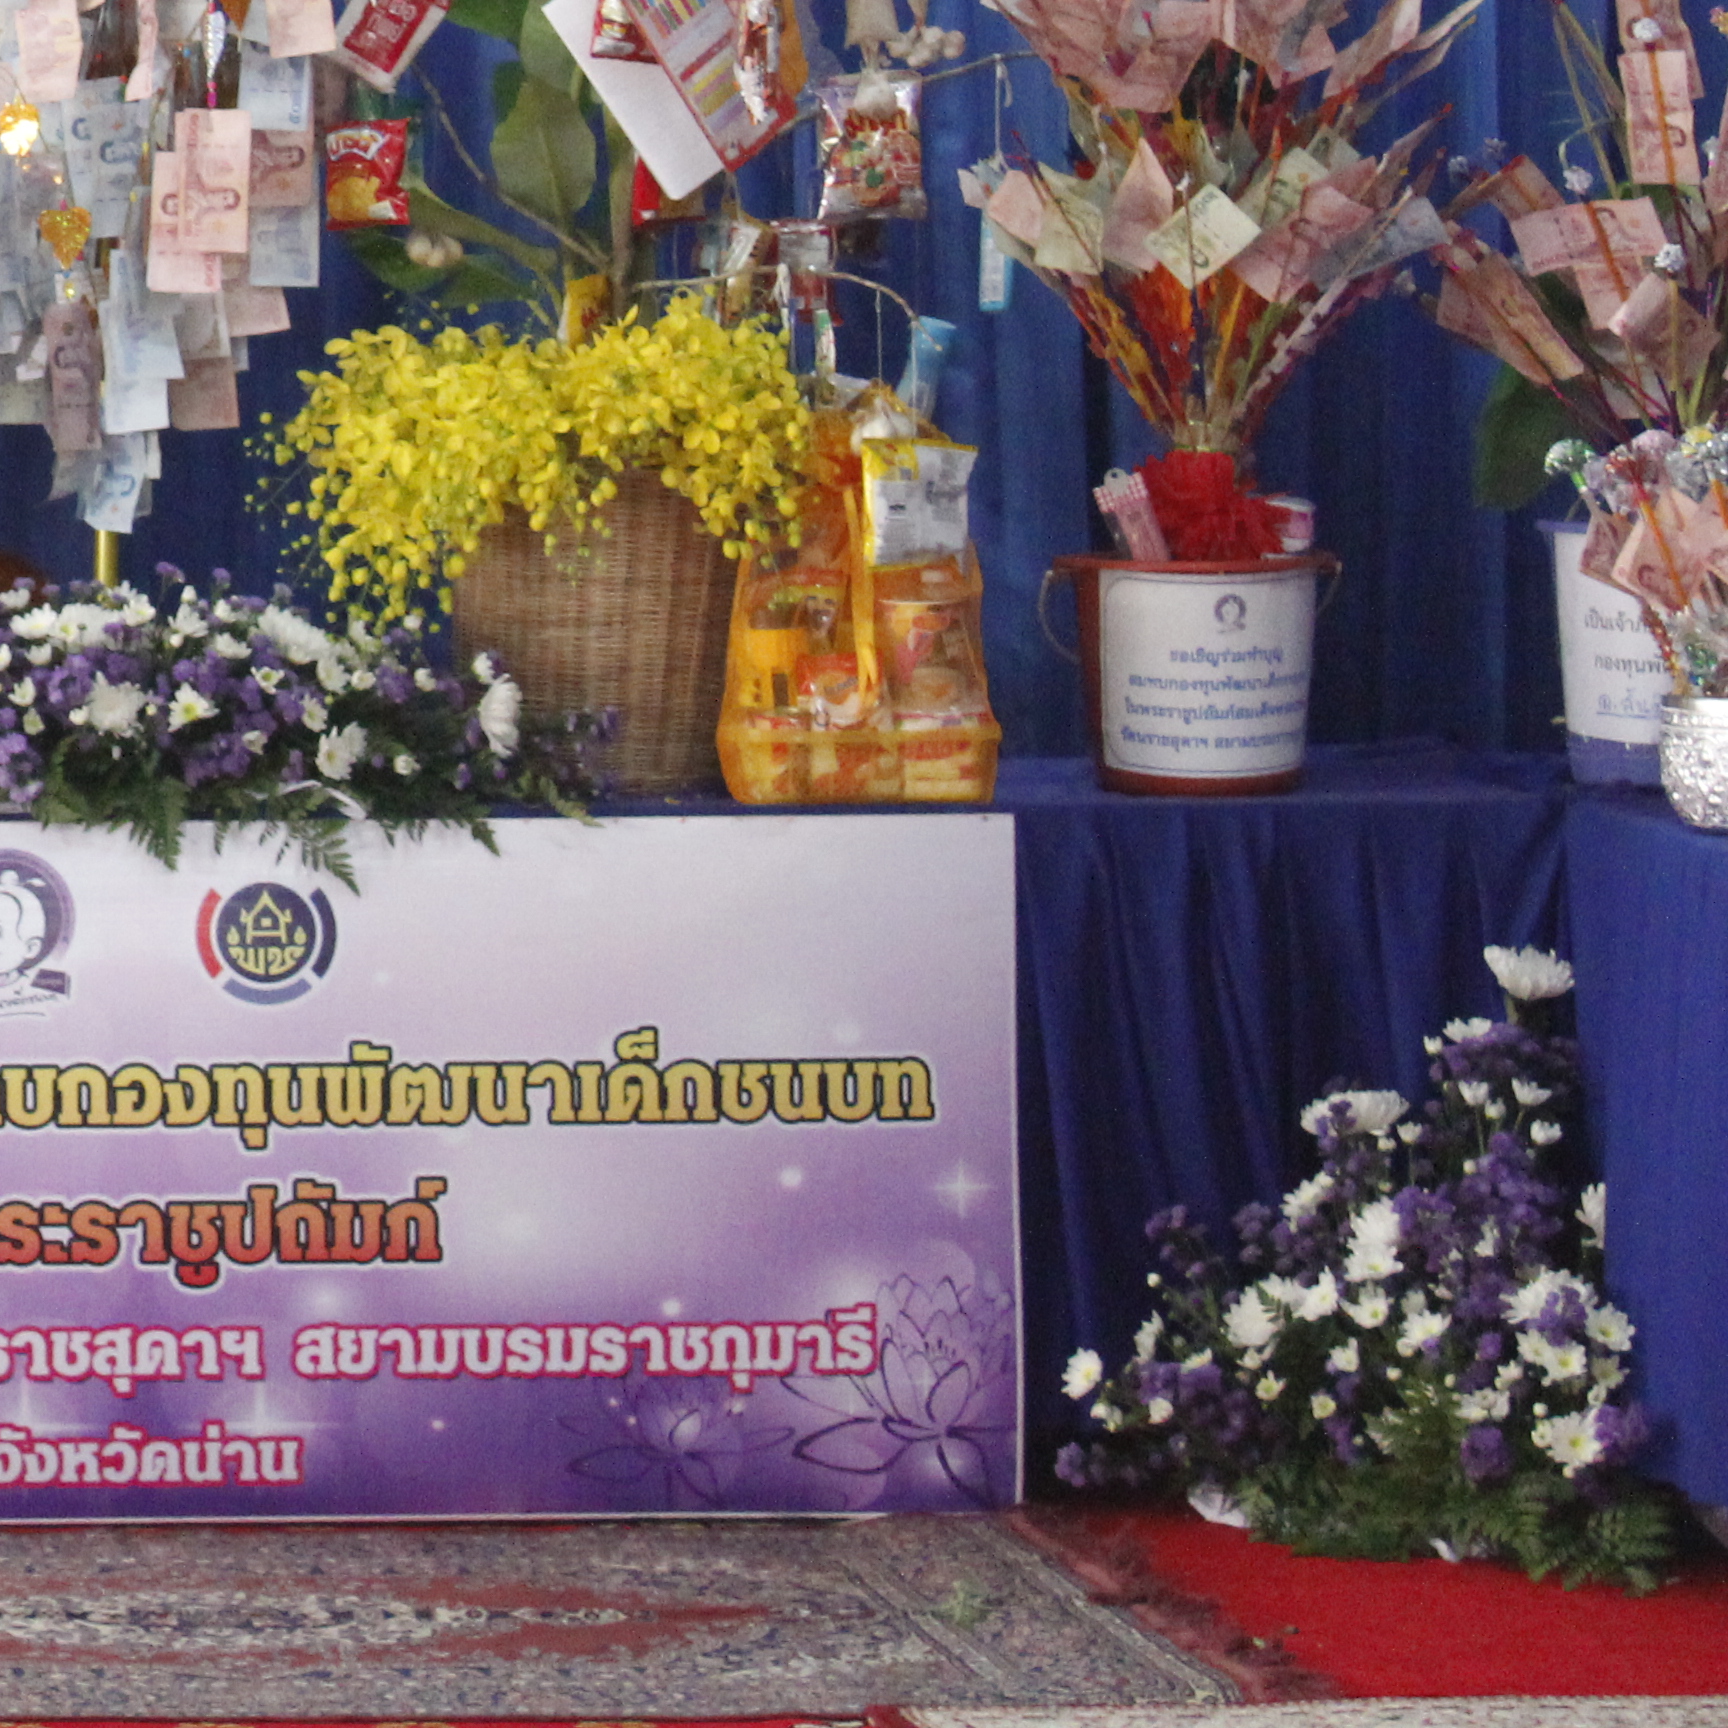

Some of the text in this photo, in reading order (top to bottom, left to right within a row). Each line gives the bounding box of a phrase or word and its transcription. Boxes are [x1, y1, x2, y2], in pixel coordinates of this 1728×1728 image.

[291, 1302, 881, 1394] สยามบรมราชกุมารี
